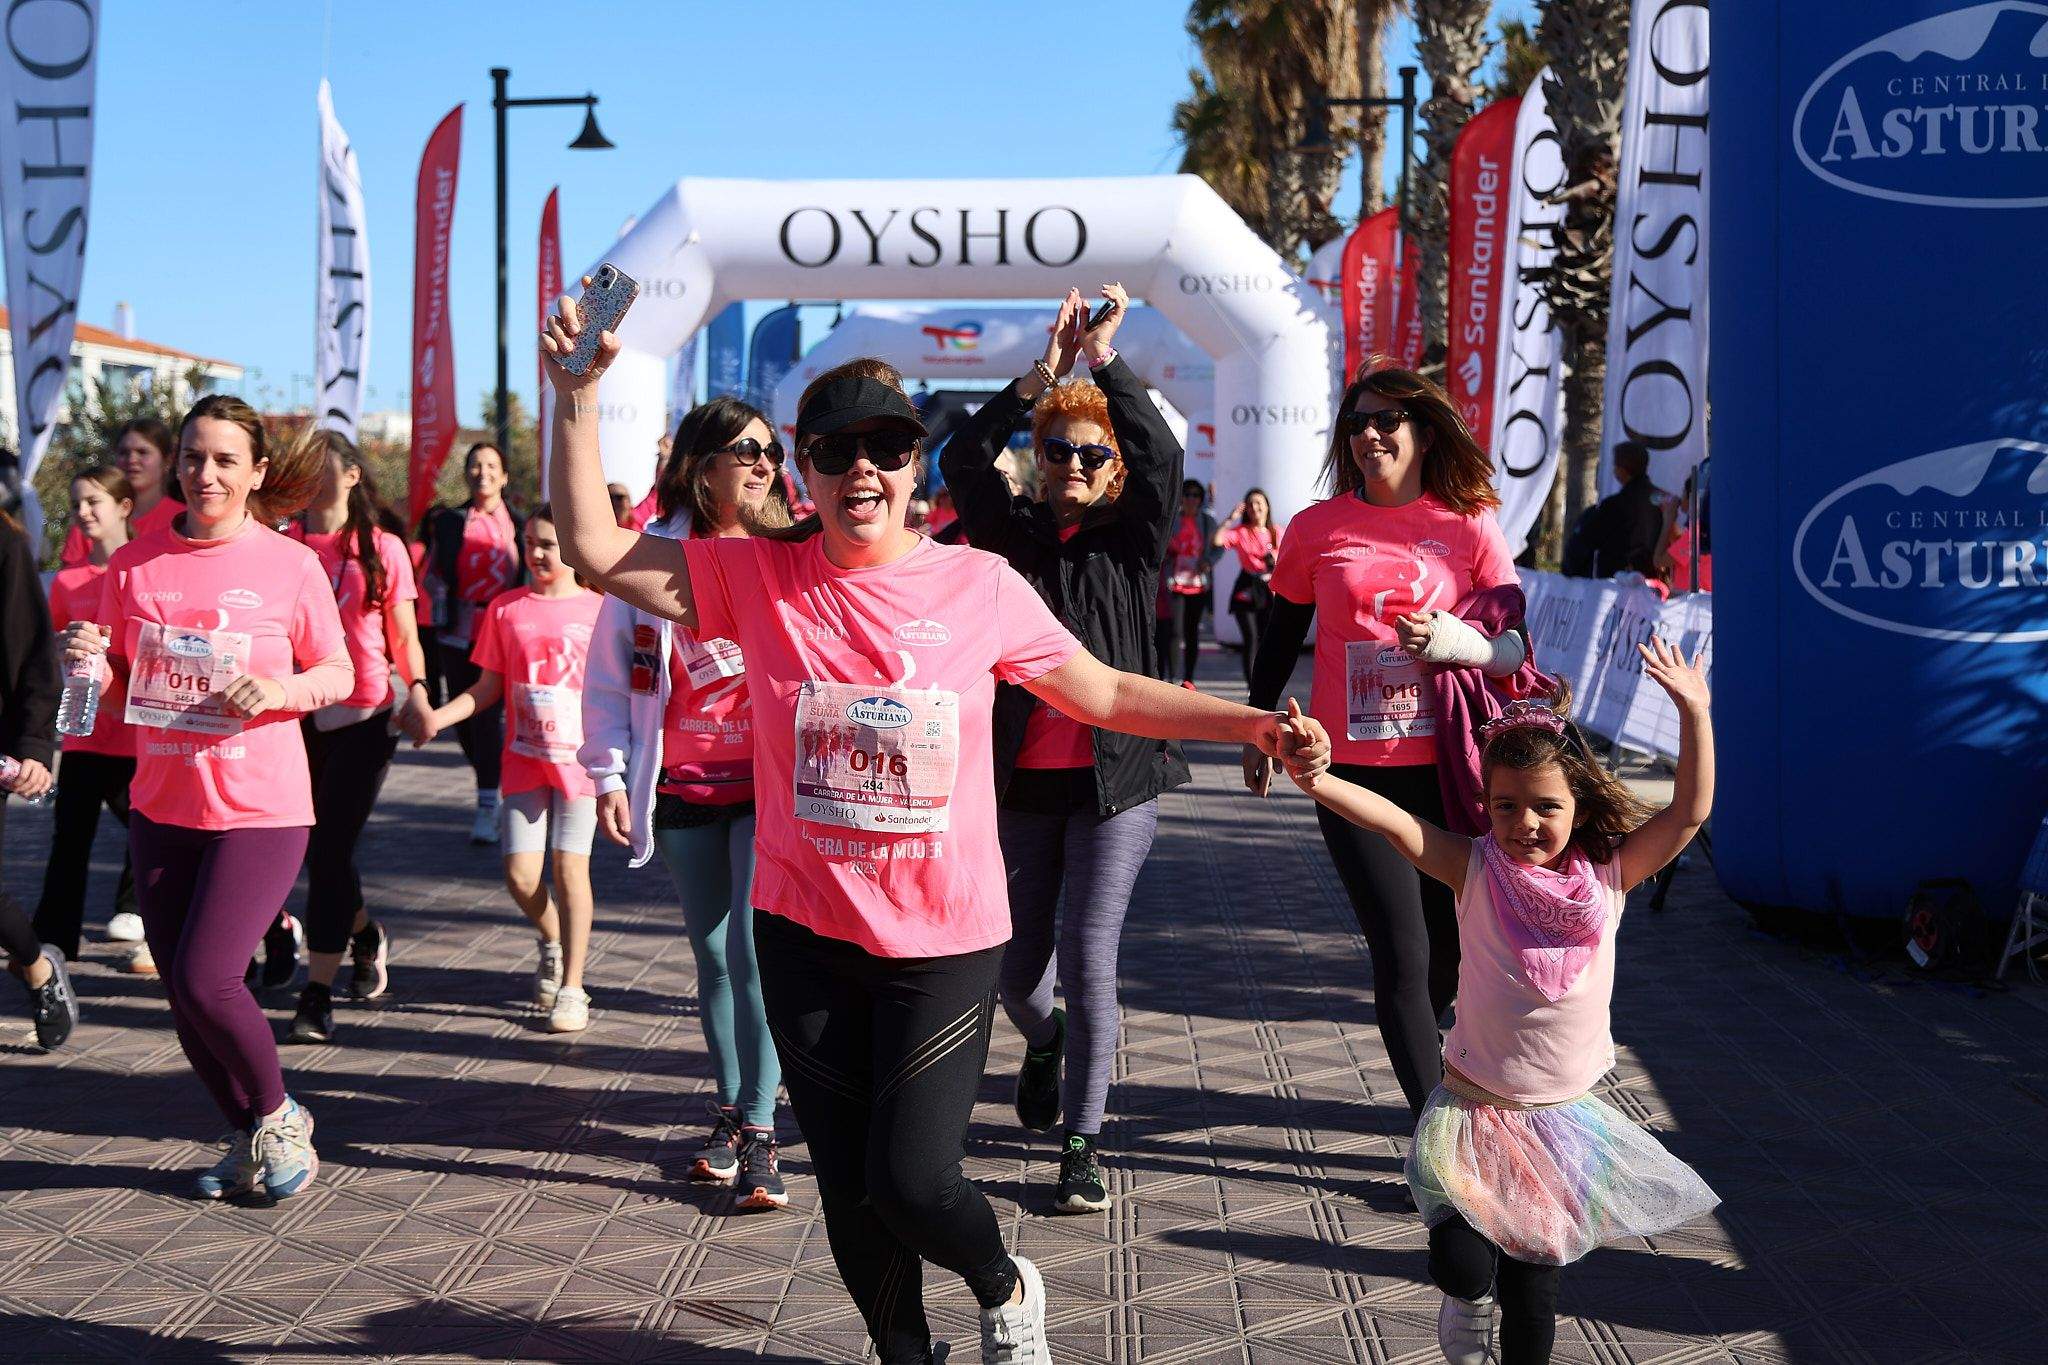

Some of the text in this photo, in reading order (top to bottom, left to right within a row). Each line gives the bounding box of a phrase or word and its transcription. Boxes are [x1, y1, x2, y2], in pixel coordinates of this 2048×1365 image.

[1887, 73, 2026, 96] CENTRAL
[1620, 0, 1710, 451] OYSHO
[779, 206, 1088, 268] OYSHO
[1464, 154, 1500, 346] Santander
[1179, 273, 1273, 296] OYSHO
[1357, 253, 1378, 360] ntander
[1231, 404, 1318, 426] OYSHO
[1886, 510, 2024, 529] CENTRAL
[900, 629, 947, 641] ASTURIANA
[168, 673, 210, 692] 016
[1382, 682, 1422, 700] 016
[810, 707, 839, 718] SUMA
[851, 706, 907, 722] ASTURIANA
[1391, 703, 1411, 711] 1695
[679, 717, 750, 734] CARRERA DE LA
[1360, 725, 1393, 734] OYSHO
[724, 733, 743, 744] 2025
[849, 749, 908, 776] 016
[862, 779, 884, 791] 494
[813, 788, 933, 807] CARRERA DE LA MUJER VALENCIA
[810, 802, 856, 820] OYSHO
[887, 813, 932, 825] Santander
[848, 841, 867, 858] DE
[871, 842, 889, 859] LA
[893, 841, 943, 859] MUJER
[849, 859, 878, 875] 2025
